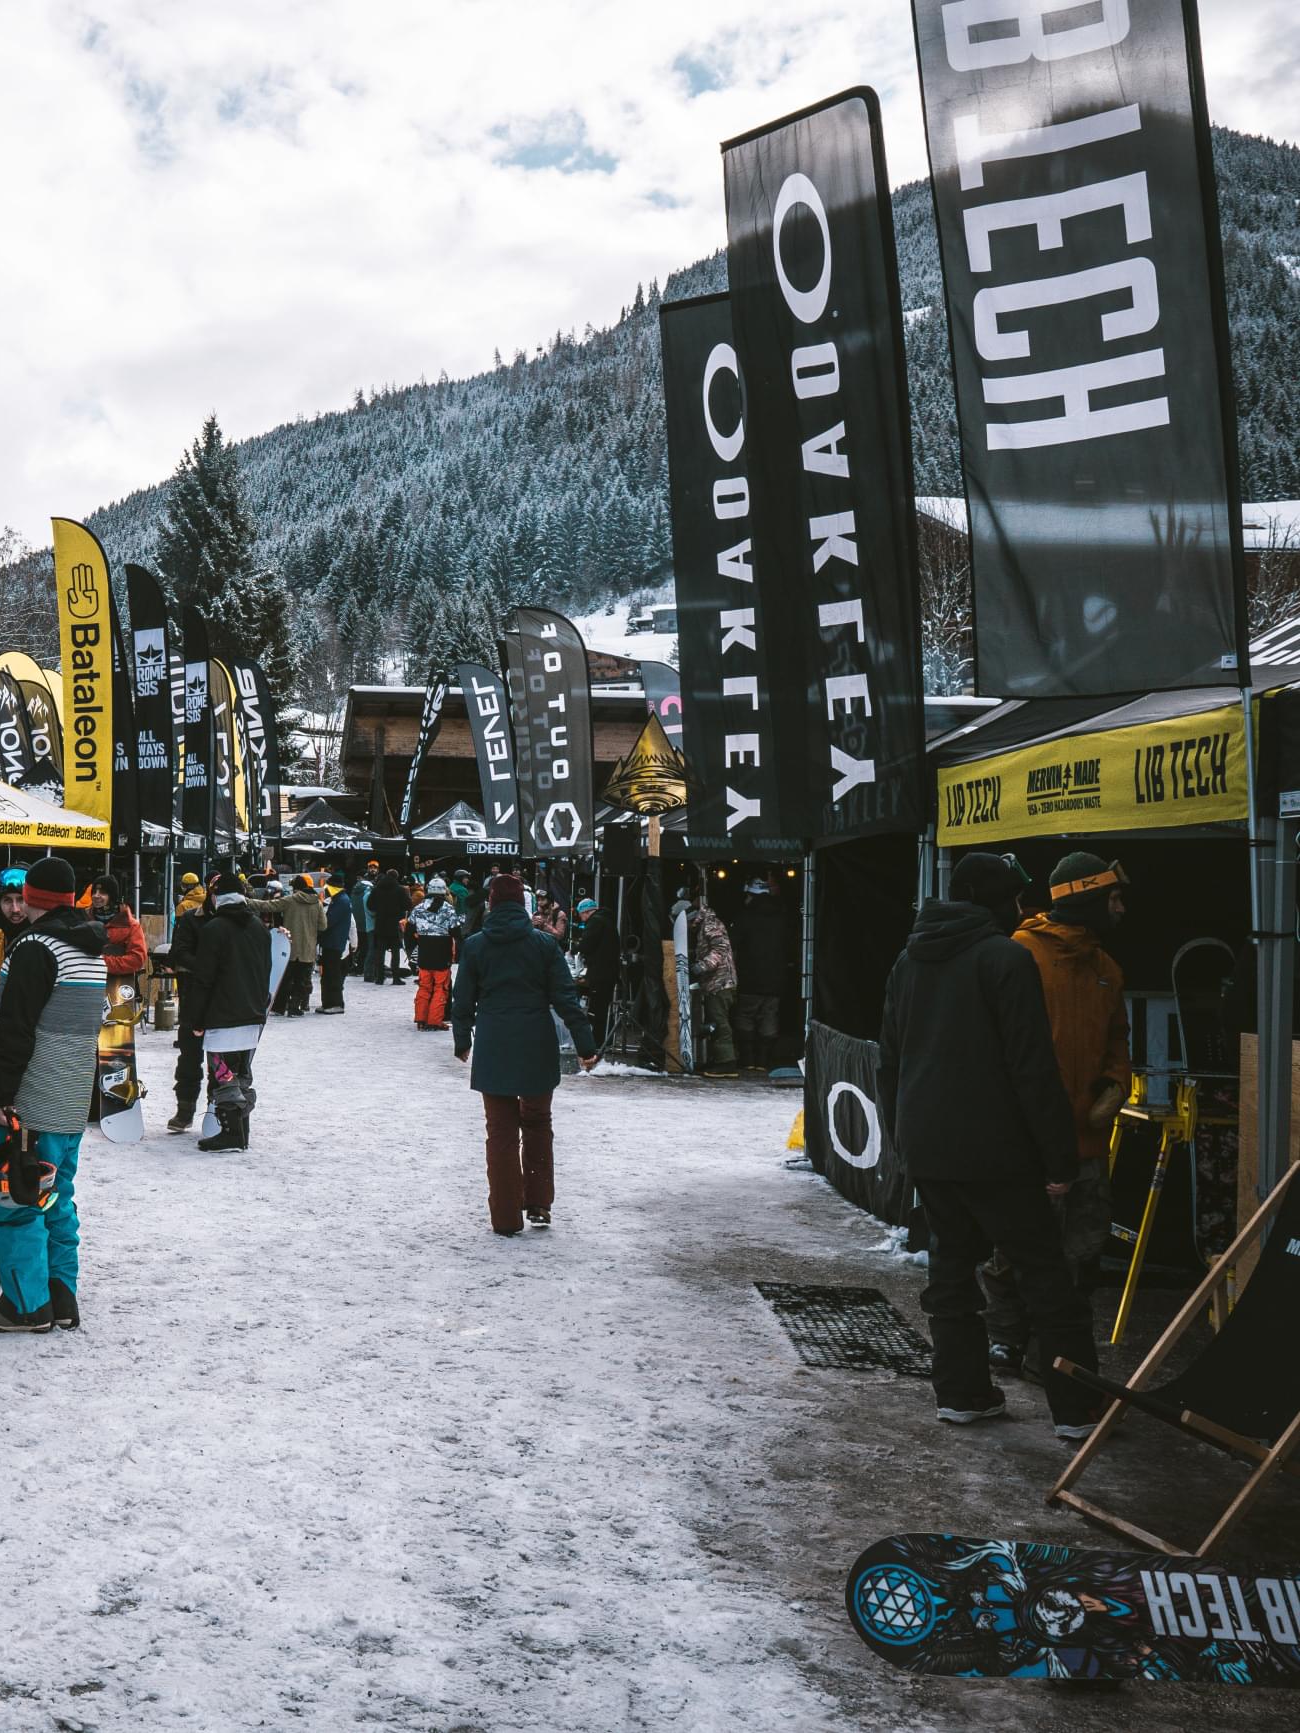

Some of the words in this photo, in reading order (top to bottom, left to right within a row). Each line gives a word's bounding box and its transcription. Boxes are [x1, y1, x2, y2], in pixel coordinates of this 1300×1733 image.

[137, 664, 167, 682] ROME
[71, 623, 104, 783] Bataleon
[185, 694, 208, 710] ROME
[138, 730, 156, 743] ALL
[138, 742, 165, 756] WAYS
[138, 755, 168, 769] DOWN
[1134, 744, 1165, 805] LIB
[1170, 732, 1231, 799] TECH
[1073, 758, 1101, 786] MADE
[946, 781, 965, 828] LIB
[966, 775, 1001, 823] TECH
[36, 821, 70, 839] Bataleon
[75, 826, 105, 842] Bataleon
[312, 840, 373, 851] DAKINE
[478, 843, 520, 855] DEELU
[1140, 1570, 1264, 1643] TECH
[1255, 1576, 1300, 1646] IB
